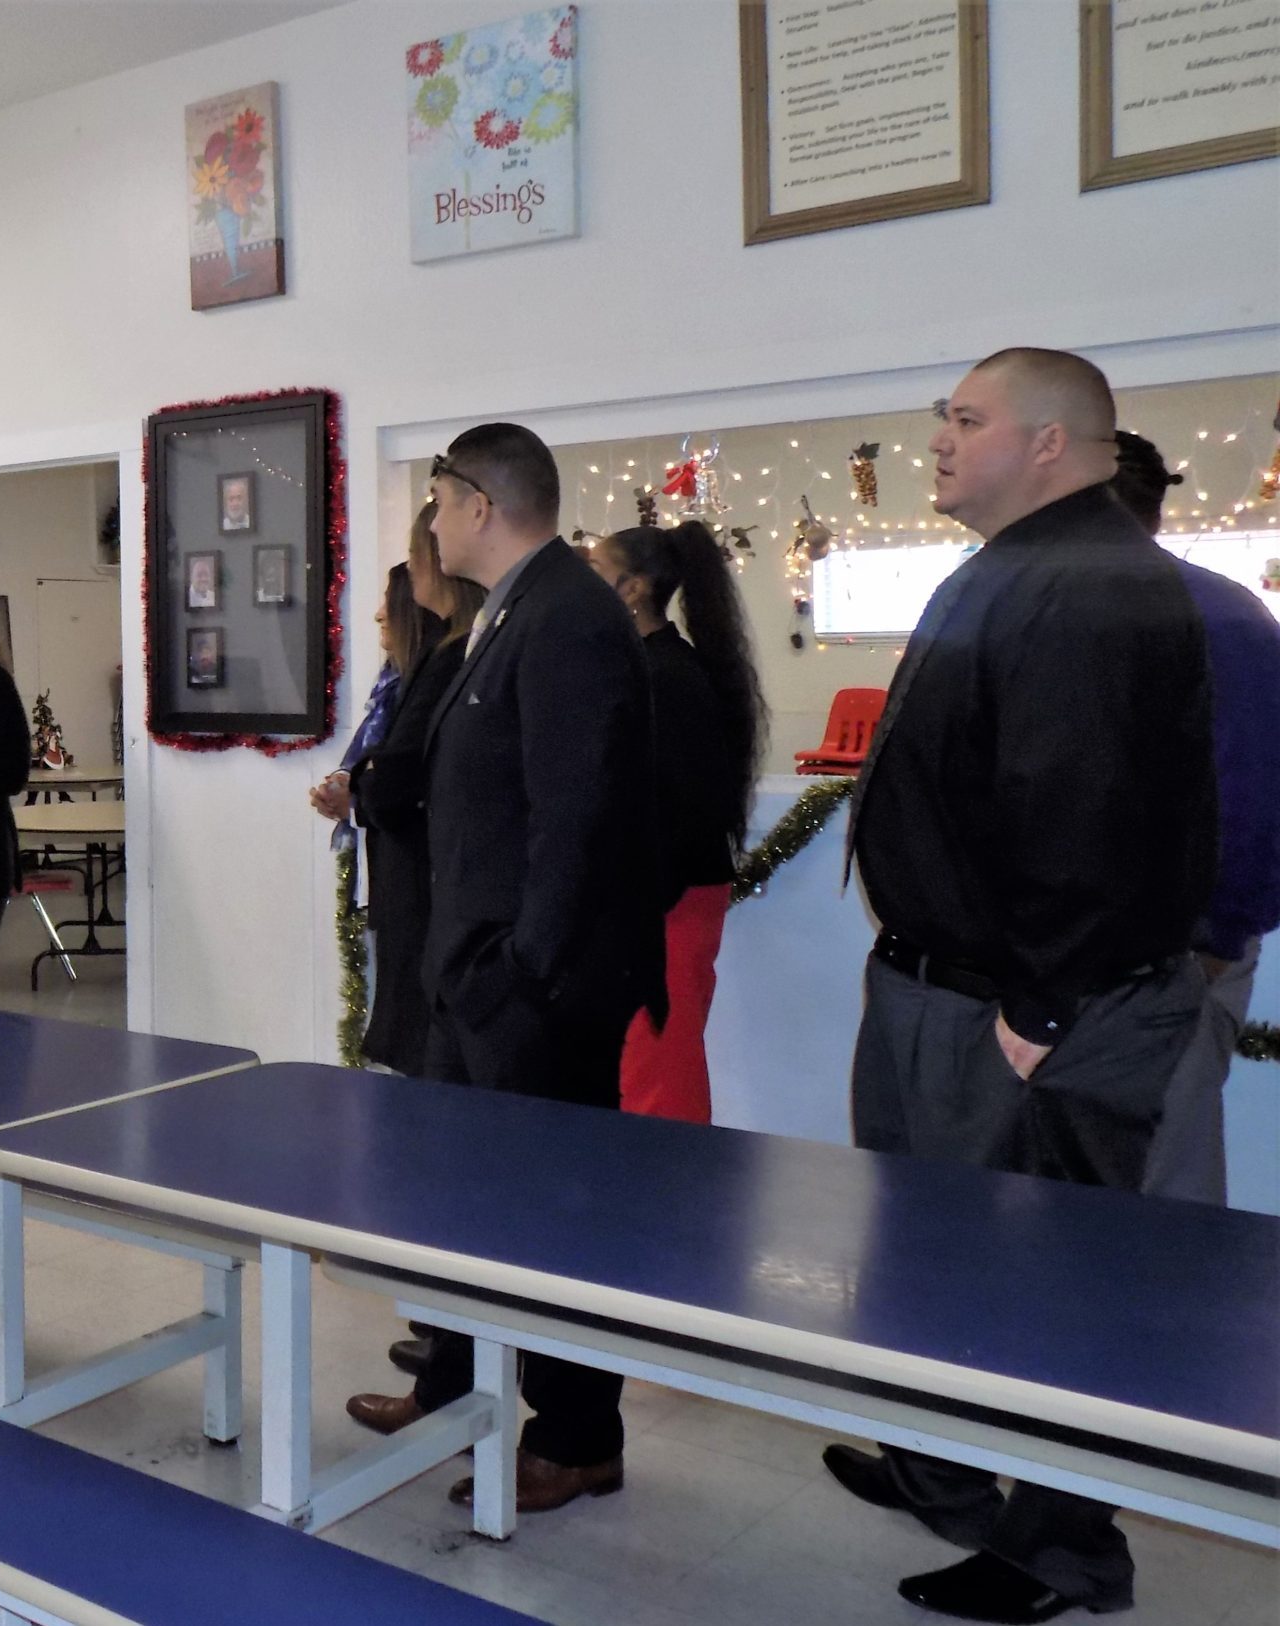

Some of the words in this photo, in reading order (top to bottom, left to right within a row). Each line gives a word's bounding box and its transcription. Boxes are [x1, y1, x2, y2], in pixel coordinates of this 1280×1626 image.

[1113, 17, 1139, 34] and
[1140, 11, 1169, 25] what
[1200, 1, 1219, 12] the
[851, 45, 866, 55] and
[913, 31, 922, 40] of
[922, 28, 937, 37] the
[1167, 38, 1180, 47] to
[1181, 33, 1197, 44] do
[1245, 16, 1271, 31] and
[897, 60, 913, 69] you
[876, 77, 890, 85] the
[1123, 98, 1146, 111] and
[1146, 97, 1159, 107] to
[1162, 89, 1189, 103] walk
[1192, 81, 1238, 98] humbly
[1240, 74, 1267, 88] with
[932, 102, 947, 110] the
[889, 123, 903, 131] the
[921, 116, 931, 124] of
[874, 138, 888, 146] the
[435, 179, 545, 224] Blessings
